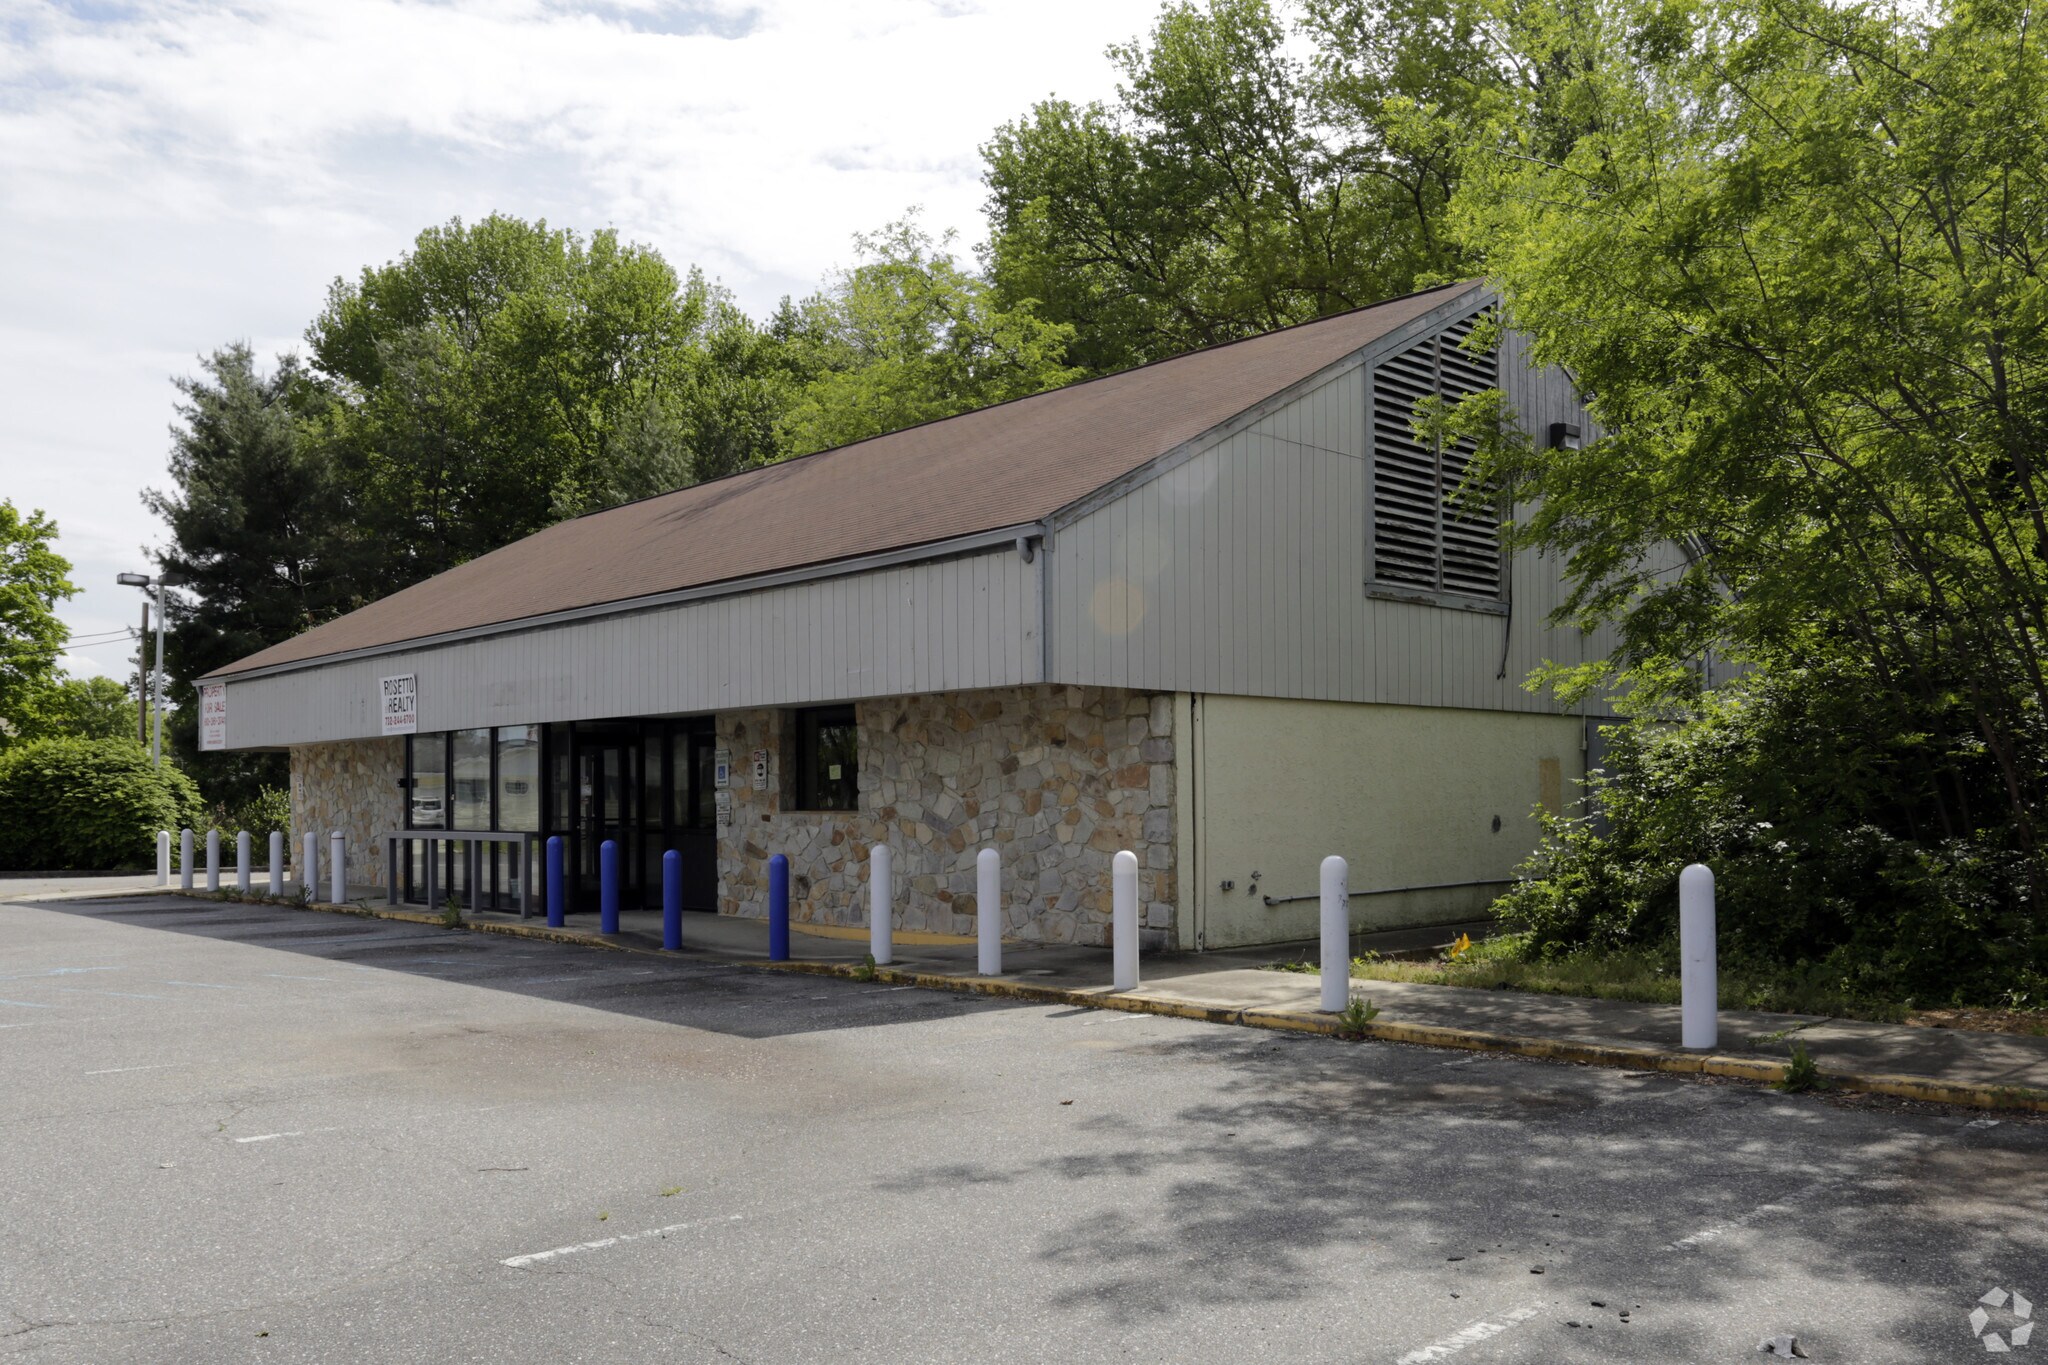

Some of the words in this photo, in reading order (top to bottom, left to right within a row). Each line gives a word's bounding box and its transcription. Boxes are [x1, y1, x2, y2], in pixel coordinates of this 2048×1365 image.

[203, 685, 225, 697] PROPERTY
[384, 677, 414, 696] ROSETTO
[214, 701, 225, 712] SALE
[388, 695, 415, 713] REALTY
